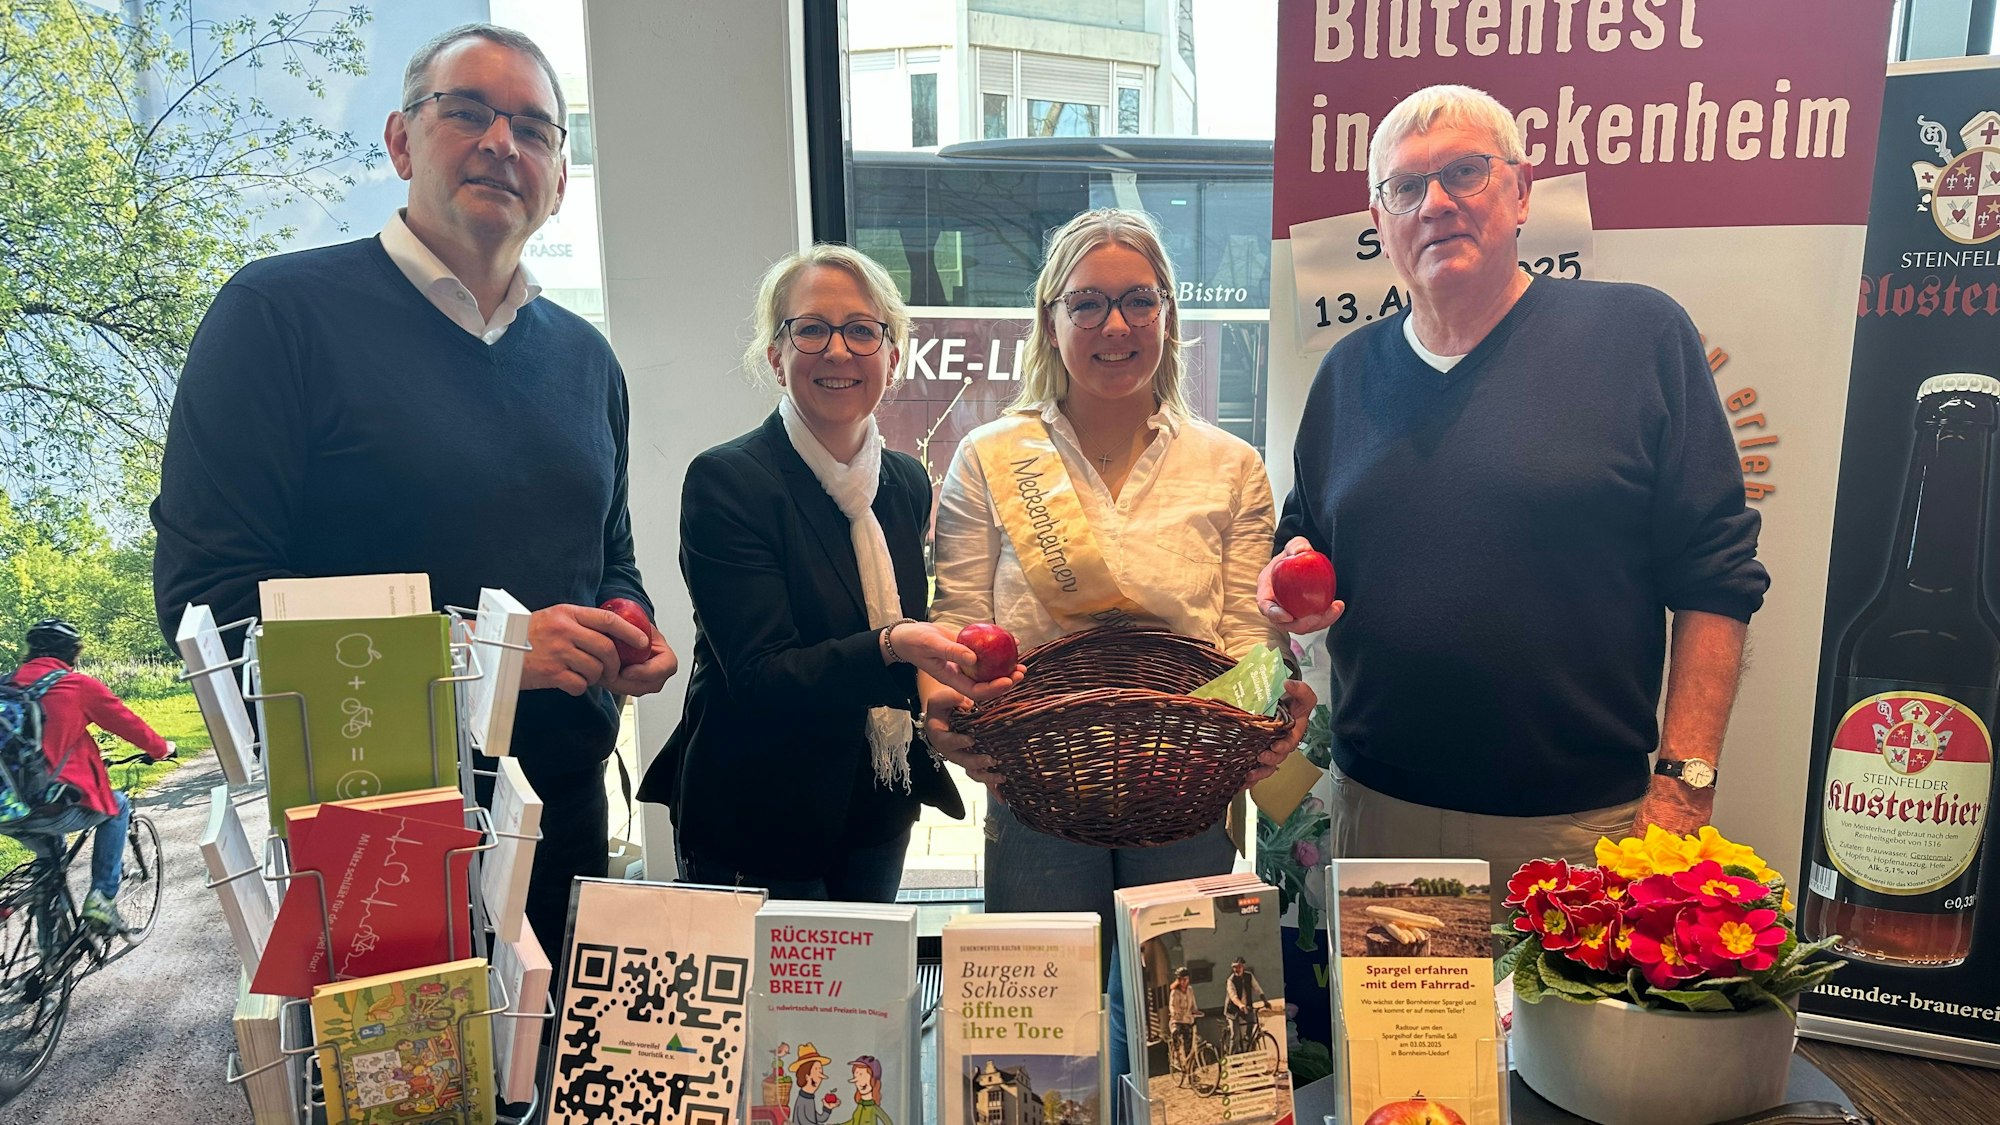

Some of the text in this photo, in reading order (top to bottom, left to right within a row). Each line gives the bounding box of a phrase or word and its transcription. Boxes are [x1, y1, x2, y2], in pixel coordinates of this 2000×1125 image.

[1311, 79, 1850, 172] in ckenheim
[524, 244, 573, 257] TRASSE
[1900, 251, 2000, 268] STEINFEL
[1179, 281, 1248, 302] Bistro
[1863, 773, 1949, 791] STEINFELDER
[1828, 779, 1981, 826] Klosterbier
[1853, 822, 1896, 835] Meisterhand
[1898, 829, 1926, 840] gebraut
[1927, 831, 1944, 839] nach
[1854, 832, 1906, 845] Reinheitsgebot
[1924, 840, 1942, 848] 1516
[1868, 864, 1882, 872] Alk.
[1241, 904, 1260, 915] adfc
[770, 925, 874, 946] RÜCKSICHT
[770, 946, 837, 961] MACHT
[769, 963, 822, 978] WEGE
[961, 961, 1058, 984] Burgen &
[1366, 965, 1468, 977] Spargel erfahren
[769, 980, 825, 995] BREIT
[962, 980, 1058, 999] Schlösser
[1361, 980, 1475, 989] -mit dem Fahrrad-
[834, 1006, 857, 1014] Freizeit
[962, 1001, 1033, 1018] öffnen
[1442, 999, 1464, 1007] Spargel
[962, 1022, 1064, 1039] ihre Tore
[1382, 1032, 1412, 1040] Spargelhof
[619, 1039, 660, 1050] rhein-voreifel
[638, 1050, 663, 1059] touristik
